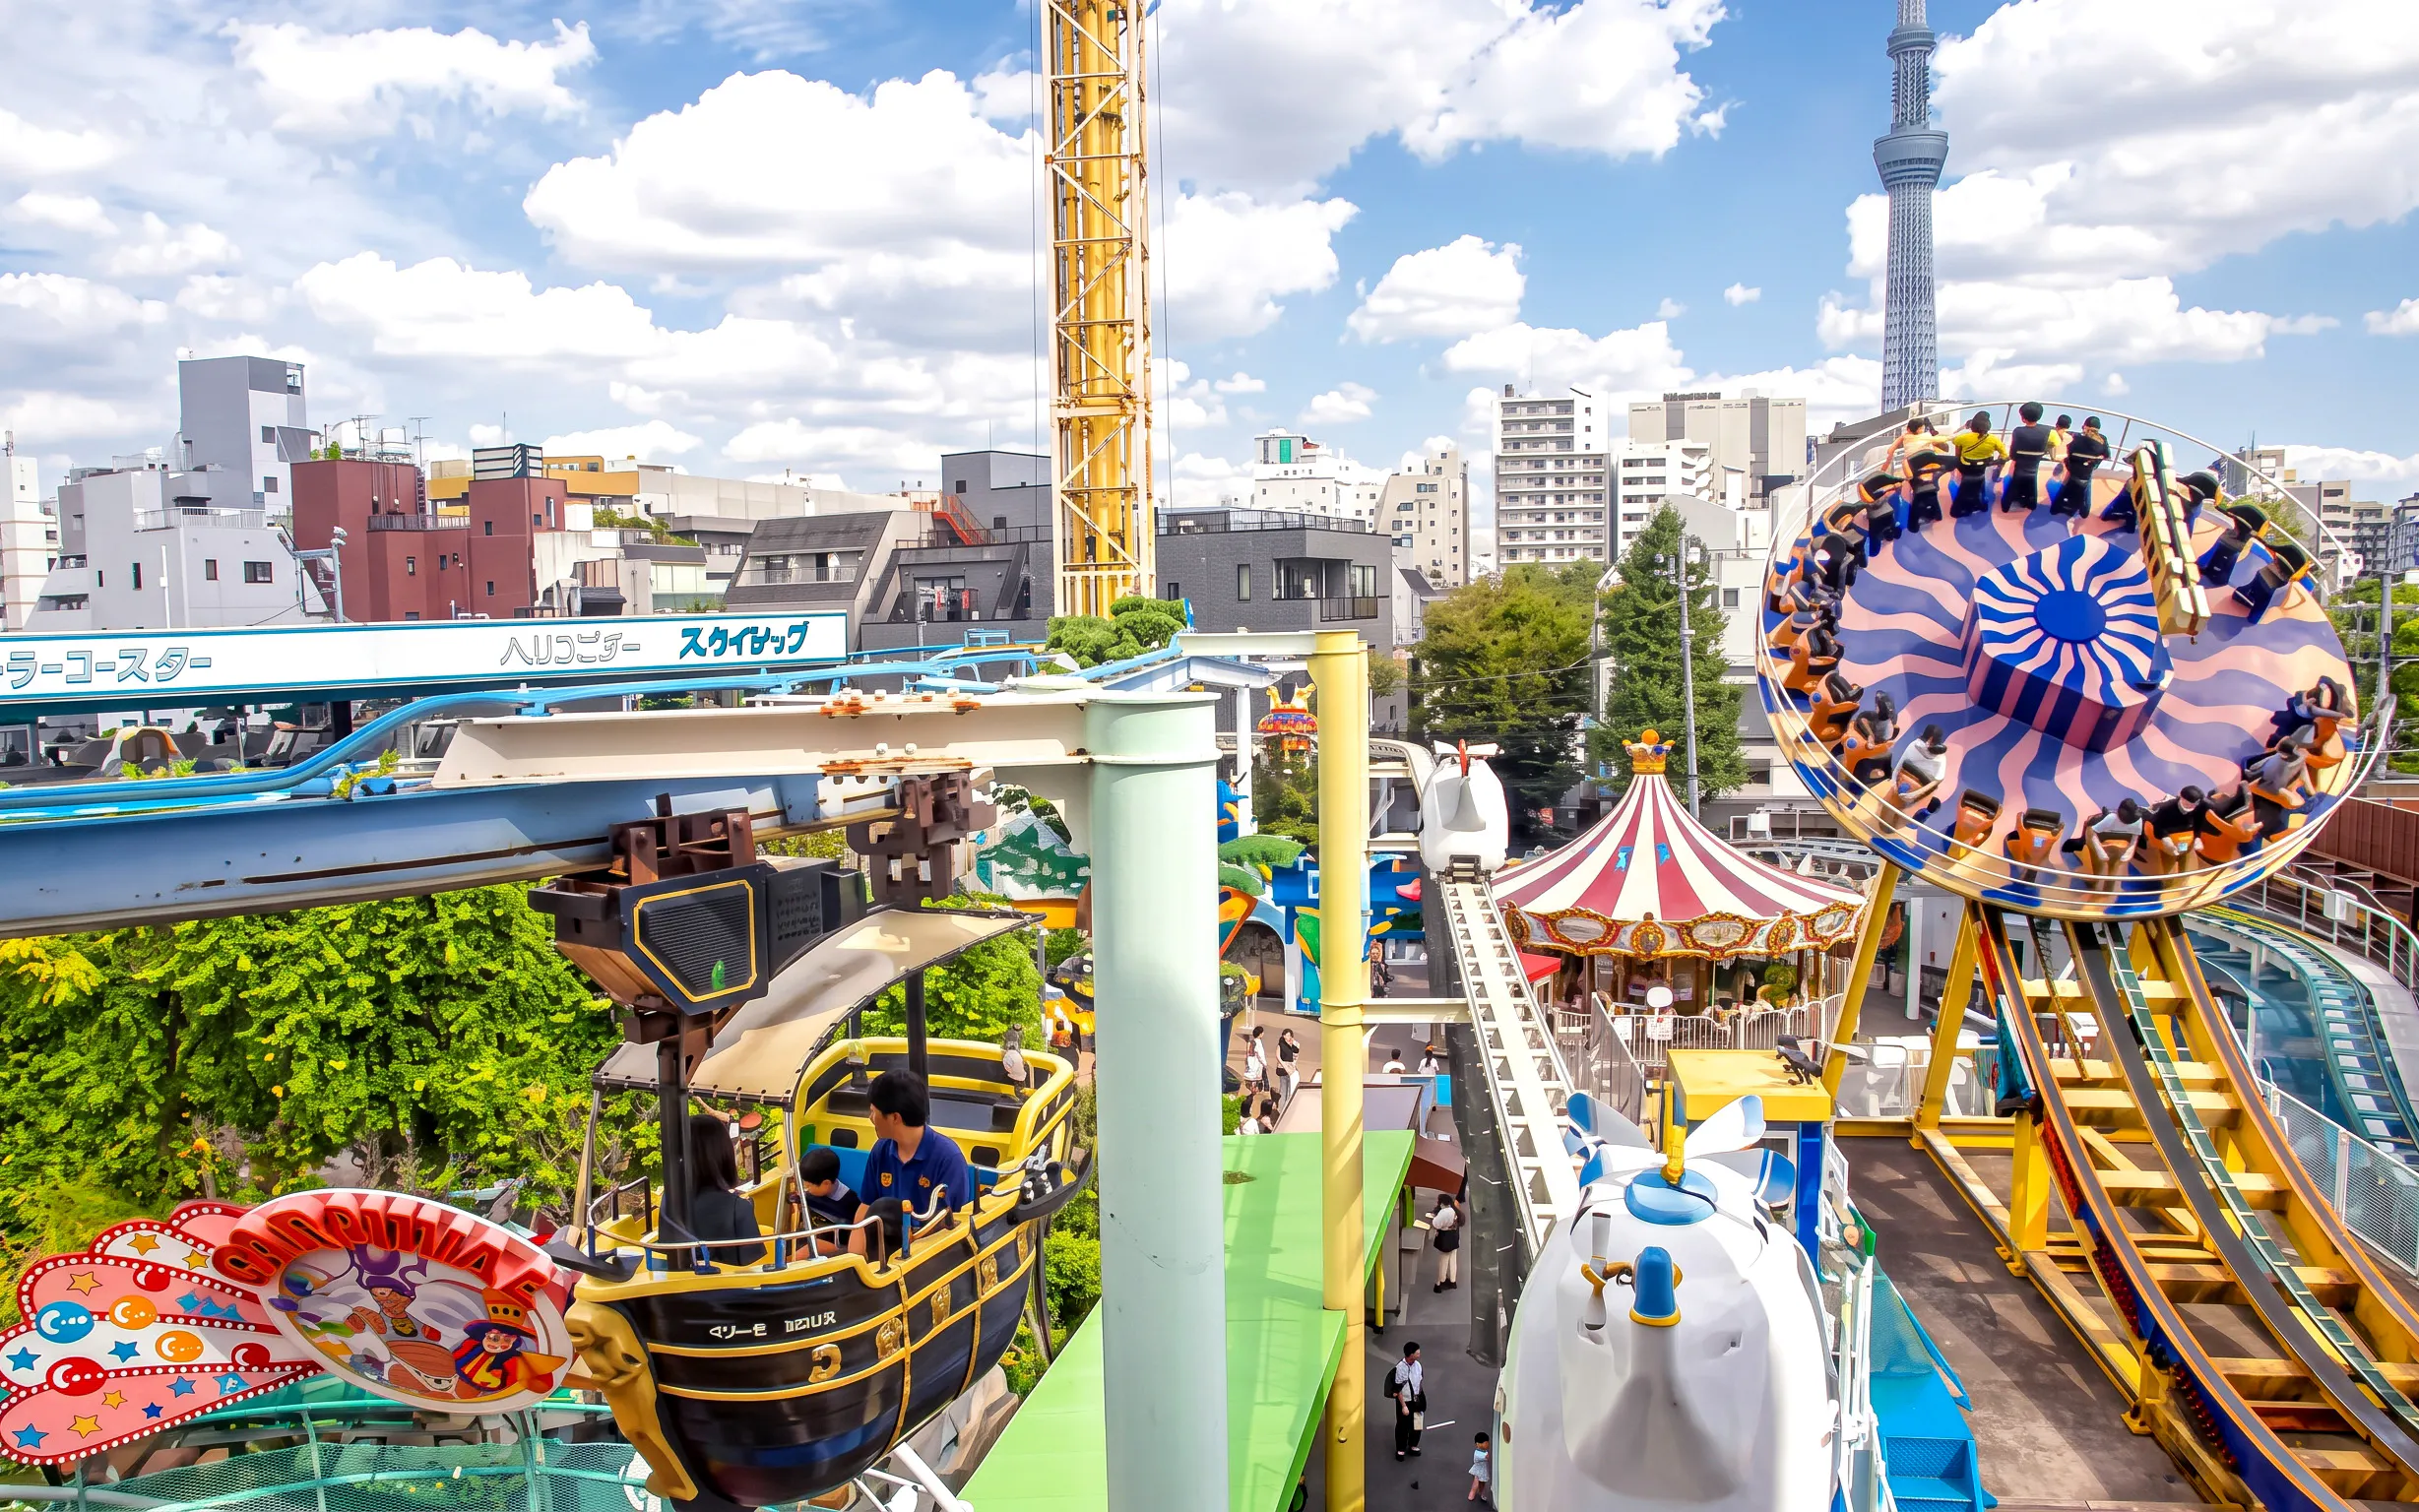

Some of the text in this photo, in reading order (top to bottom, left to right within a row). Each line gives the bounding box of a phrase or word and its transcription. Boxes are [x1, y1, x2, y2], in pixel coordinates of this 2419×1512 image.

[0, 647, 212, 689] ラーコースター
